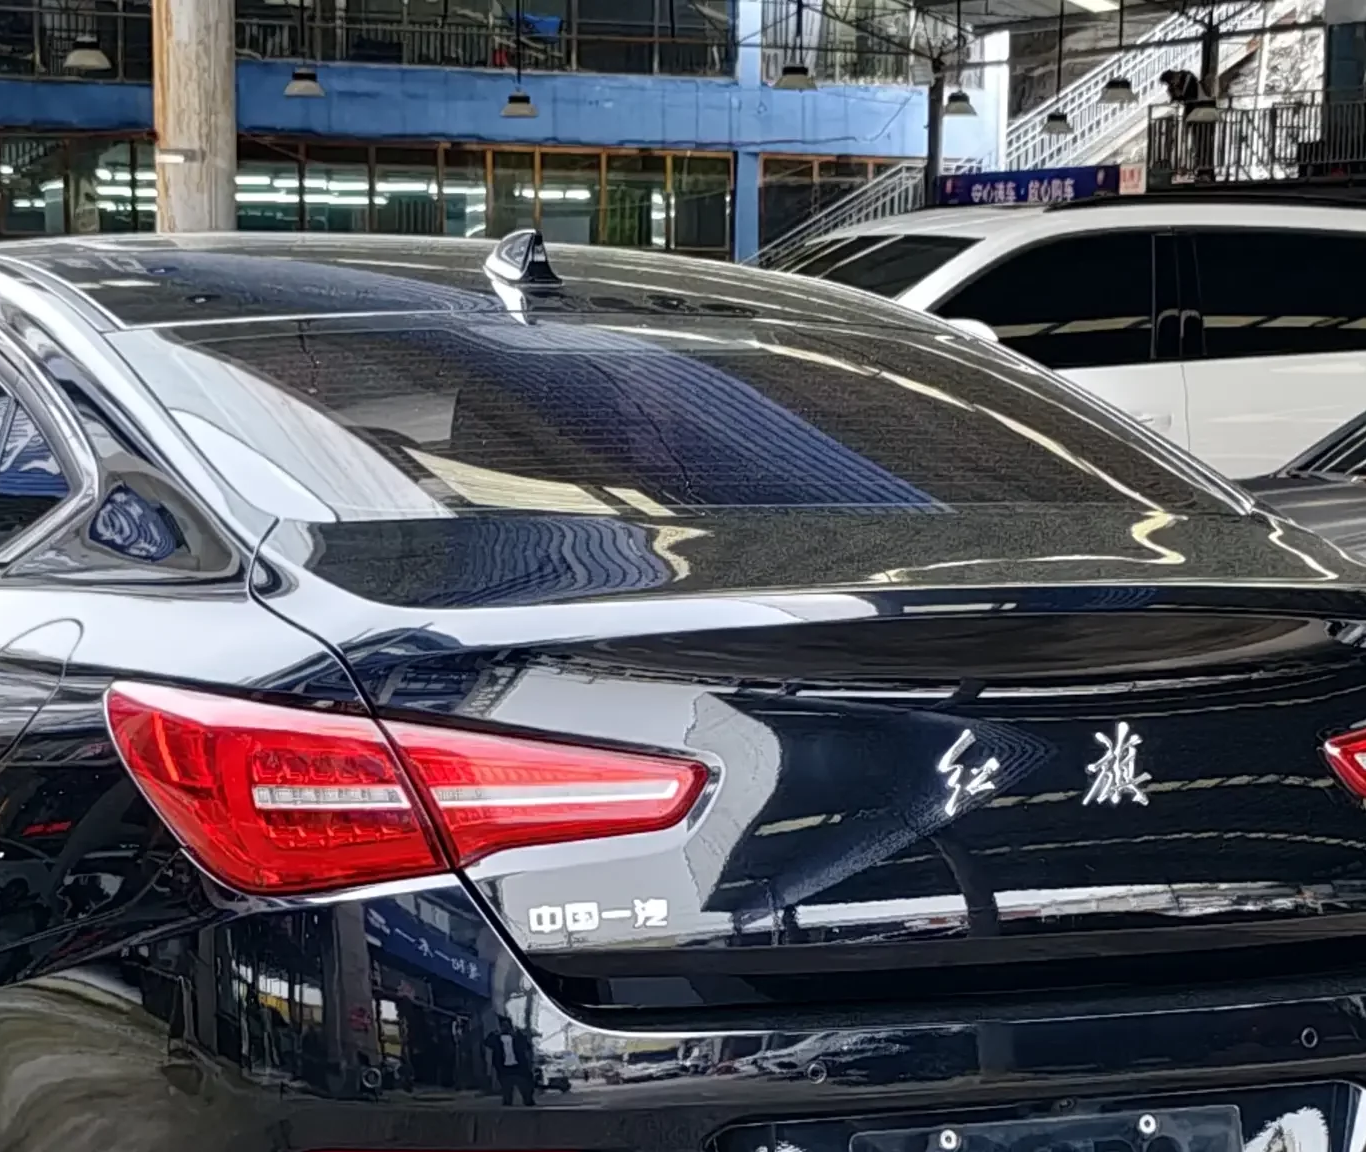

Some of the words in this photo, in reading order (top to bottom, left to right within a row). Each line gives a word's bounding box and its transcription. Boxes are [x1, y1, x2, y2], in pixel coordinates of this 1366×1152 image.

[938, 721, 1152, 816] 红旗
[529, 898, 668, 933] 中国一汽
